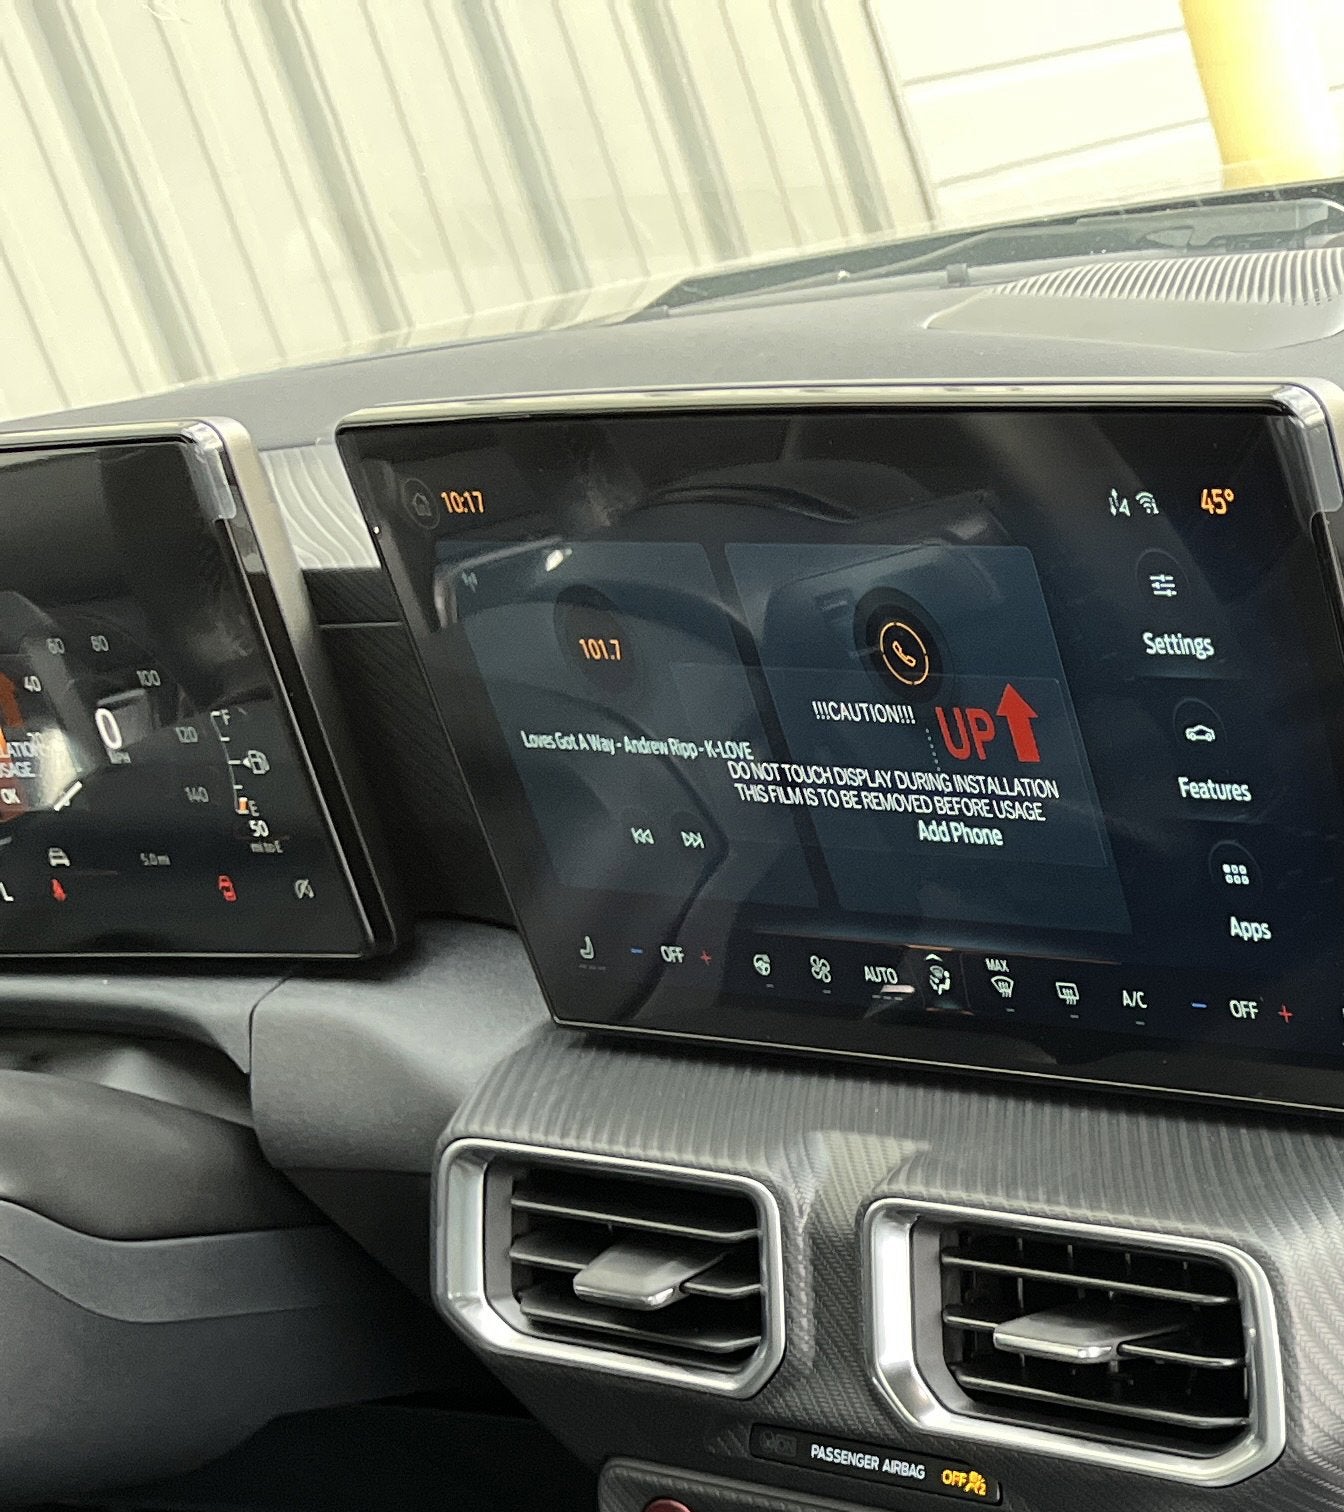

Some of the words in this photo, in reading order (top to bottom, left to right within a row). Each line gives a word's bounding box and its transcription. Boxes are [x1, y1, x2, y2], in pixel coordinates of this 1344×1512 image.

[441, 491, 485, 514] 10:17
[579, 638, 622, 661] 101.7
[1142, 632, 1215, 660] Settings
[24, 675, 42, 692] 40
[136, 670, 161, 686] 100
[811, 701, 917, 725] !!!CAUTION!!!
[95, 707, 123, 750] 0
[175, 726, 198, 743] 120
[935, 706, 997, 761] UP
[555, 731, 580, 751] Got
[577, 733, 590, 751] A
[586, 733, 616, 756] Way
[623, 736, 669, 756] Andrew
[667, 737, 699, 761] Ripp
[703, 739, 755, 761] K-LOVE
[727, 761, 750, 780] DO
[749, 762, 781, 782] NOT
[781, 764, 834, 785] TOUCH
[832, 766, 892, 789] DISPLAY
[893, 770, 953, 793] DURING
[952, 774, 1060, 799] INSTALLATION
[1178, 776, 1252, 802] Features
[734, 782, 769, 804] THIS
[767, 785, 804, 806] FILM
[802, 787, 819, 807] IS
[816, 788, 840, 809] TO
[840, 790, 863, 809] BE
[860, 791, 933, 814] REMOVED
[933, 796, 994, 818] BEFORE
[992, 799, 1047, 822] USAGE
[248, 819, 269, 837] 50
[918, 819, 950, 843] Add
[949, 821, 1004, 846] Phone
[1229, 916, 1272, 942] Apps
[660, 945, 685, 964] OFF
[985, 958, 1010, 973] MAX
[864, 965, 898, 985] AUTO
[1122, 990, 1148, 1009] A/C
[1229, 1000, 1259, 1020] OFF
[811, 1444, 880, 1471] PASSENGER
[882, 1458, 926, 1480] AIRBAG
[941, 1469, 967, 1487] OFF
